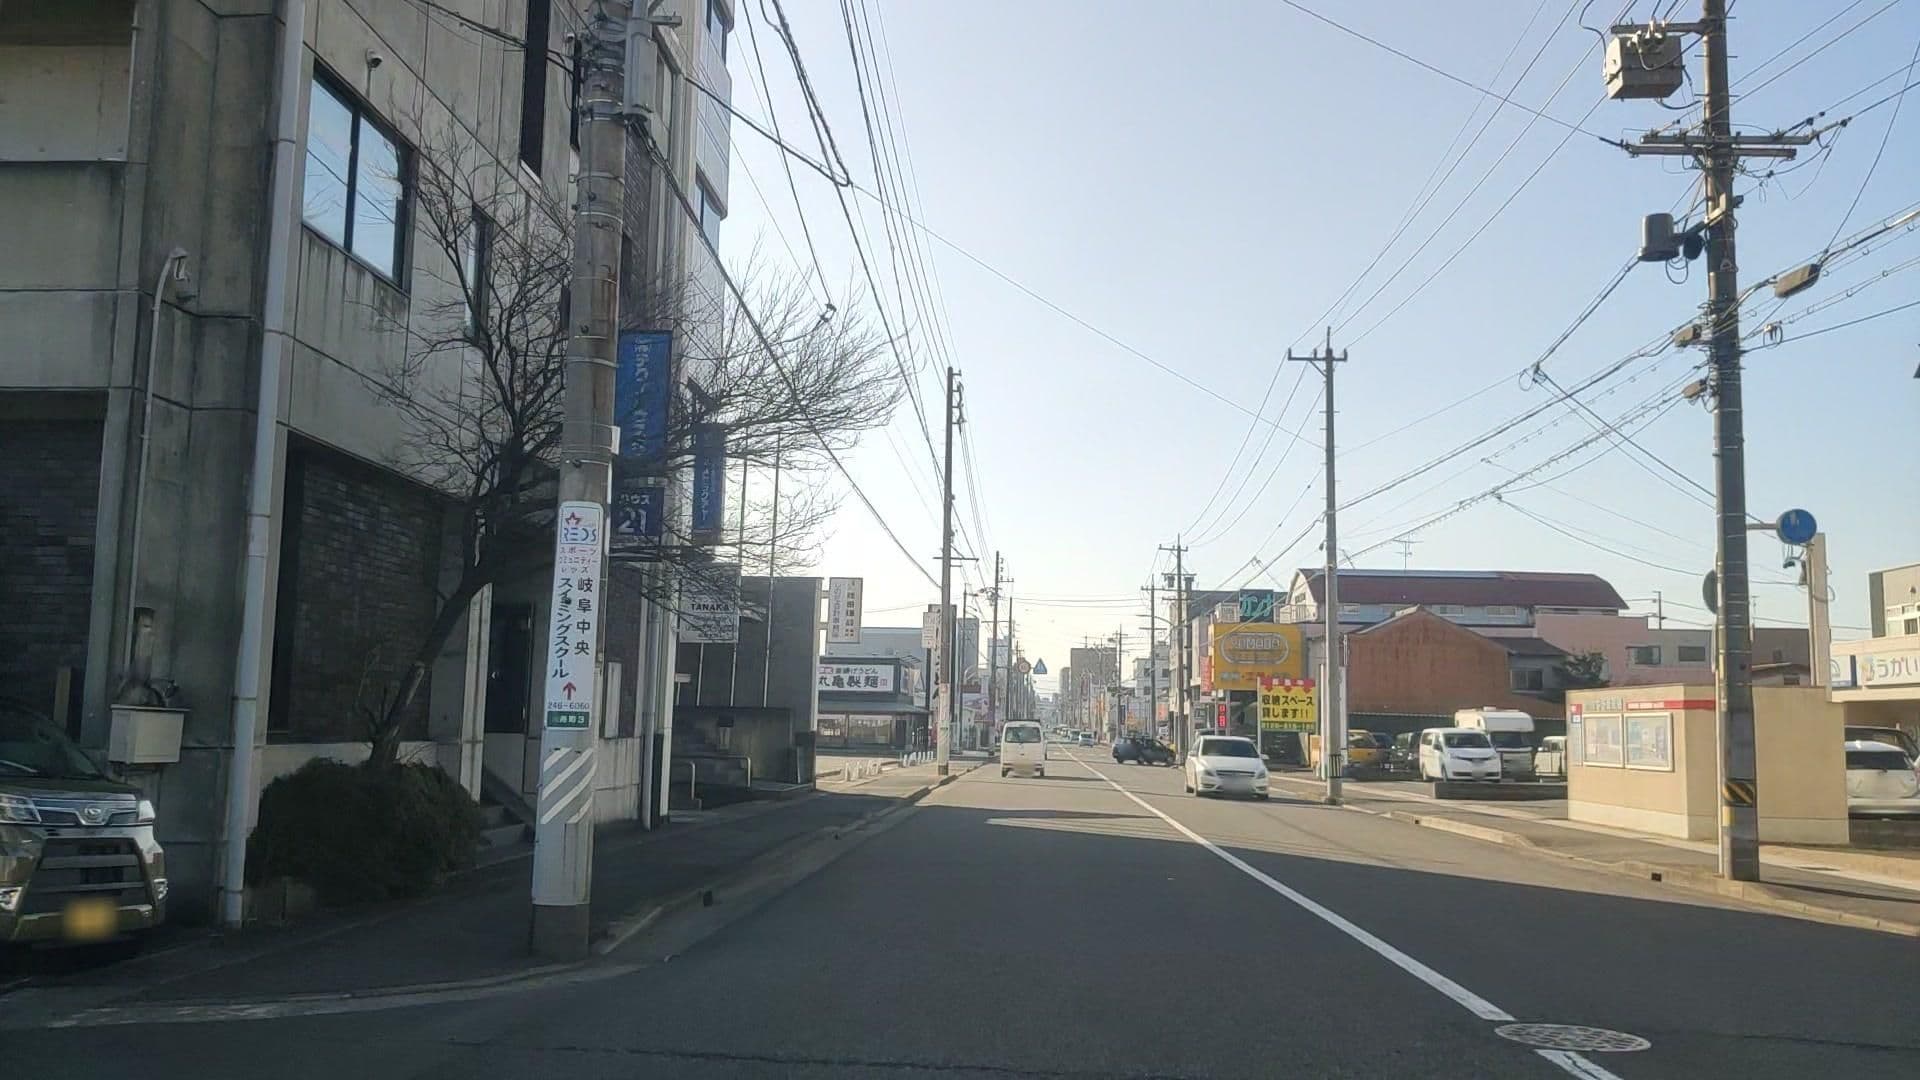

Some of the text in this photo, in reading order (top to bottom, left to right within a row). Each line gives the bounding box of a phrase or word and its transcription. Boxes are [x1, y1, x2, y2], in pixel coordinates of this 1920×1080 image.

[619, 494, 650, 505] ハウス
[618, 507, 647, 534] 21
[560, 546, 597, 556] スポーツ
[561, 566, 589, 574] レッズ
[691, 603, 730, 611] TANAKA
[574, 577, 593, 656] 岐阜中央
[552, 577, 573, 679] スイミングスクール
[818, 675, 879, 688] 丸亀製麺
[1262, 695, 1315, 706] 収納スペース
[548, 703, 590, 711] 246-6060
[1262, 707, 1309, 719] 貸します!!
